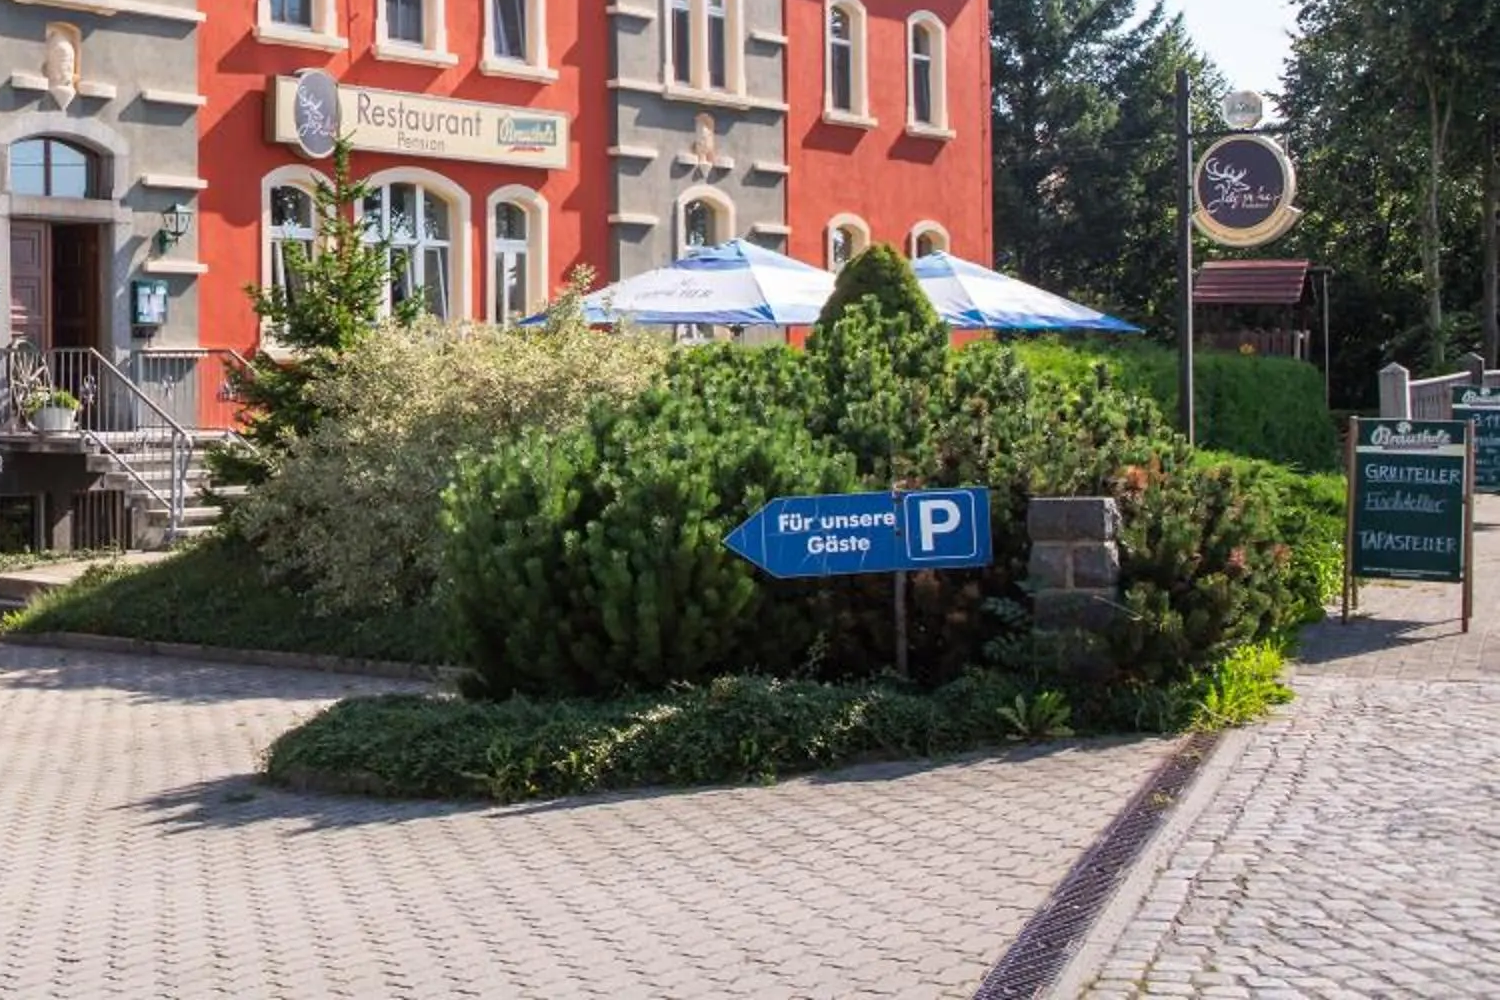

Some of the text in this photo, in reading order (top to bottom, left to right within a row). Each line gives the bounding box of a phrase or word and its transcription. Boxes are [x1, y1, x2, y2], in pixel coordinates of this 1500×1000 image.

[357, 92, 482, 137] Restaurant
[397, 131, 445, 152] Pension
[778, 500, 961, 551] Für unsere P
[807, 535, 871, 554] Gäste
